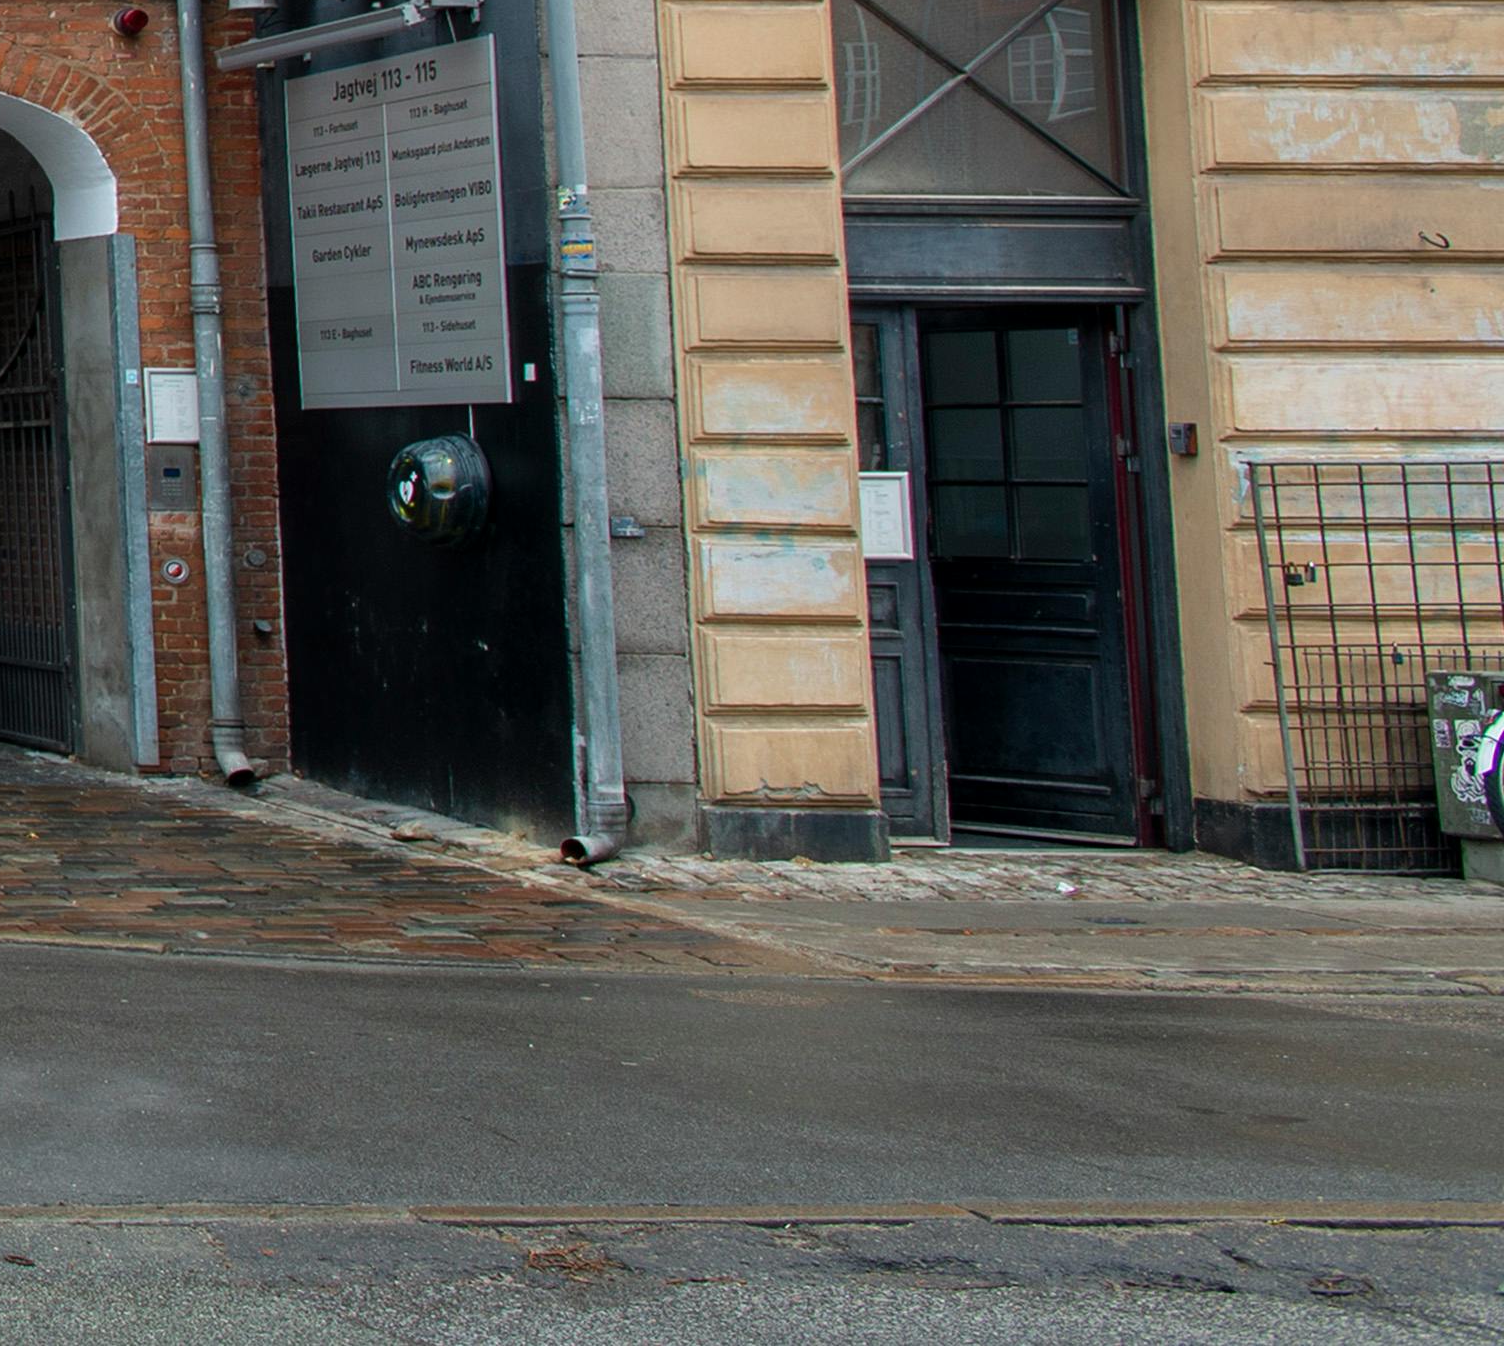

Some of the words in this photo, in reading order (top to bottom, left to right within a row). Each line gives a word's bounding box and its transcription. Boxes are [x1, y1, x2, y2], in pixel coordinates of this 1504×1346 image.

[332, 73, 377, 104] Jagtvej
[381, 67, 402, 91] 113
[414, 59, 437, 84] 115
[409, 106, 422, 120] 113
[433, 98, 468, 116] Baghuset
[313, 125, 324, 138] 113
[329, 119, 359, 135] Forhuset
[391, 142, 436, 162] Munksgaard
[437, 140, 452, 157] plus
[453, 135, 490, 152] Andersen
[294, 159, 332, 179] Lægerne
[333, 154, 364, 173] Jagtvej
[364, 149, 381, 165] 113
[394, 185, 467, 209] Boligforeningen
[468, 179, 492, 196] VIBO
[297, 205, 317, 220] Takii
[317, 197, 365, 217] Restaurant
[365, 194, 383, 214] ApS
[405, 230, 464, 253] Mynewsdesk
[465, 227, 485, 247] ApS
[311, 246, 343, 264] Garden
[343, 244, 372, 262] Cykler
[412, 273, 432, 290] ABC
[433, 269, 482, 290] Rengøring
[341, 327, 373, 341] Baghuset
[440, 319, 476, 333] Sidehuset
[410, 357, 444, 375] Fitness
[444, 357, 473, 373] World
[475, 355, 493, 372] A/S
